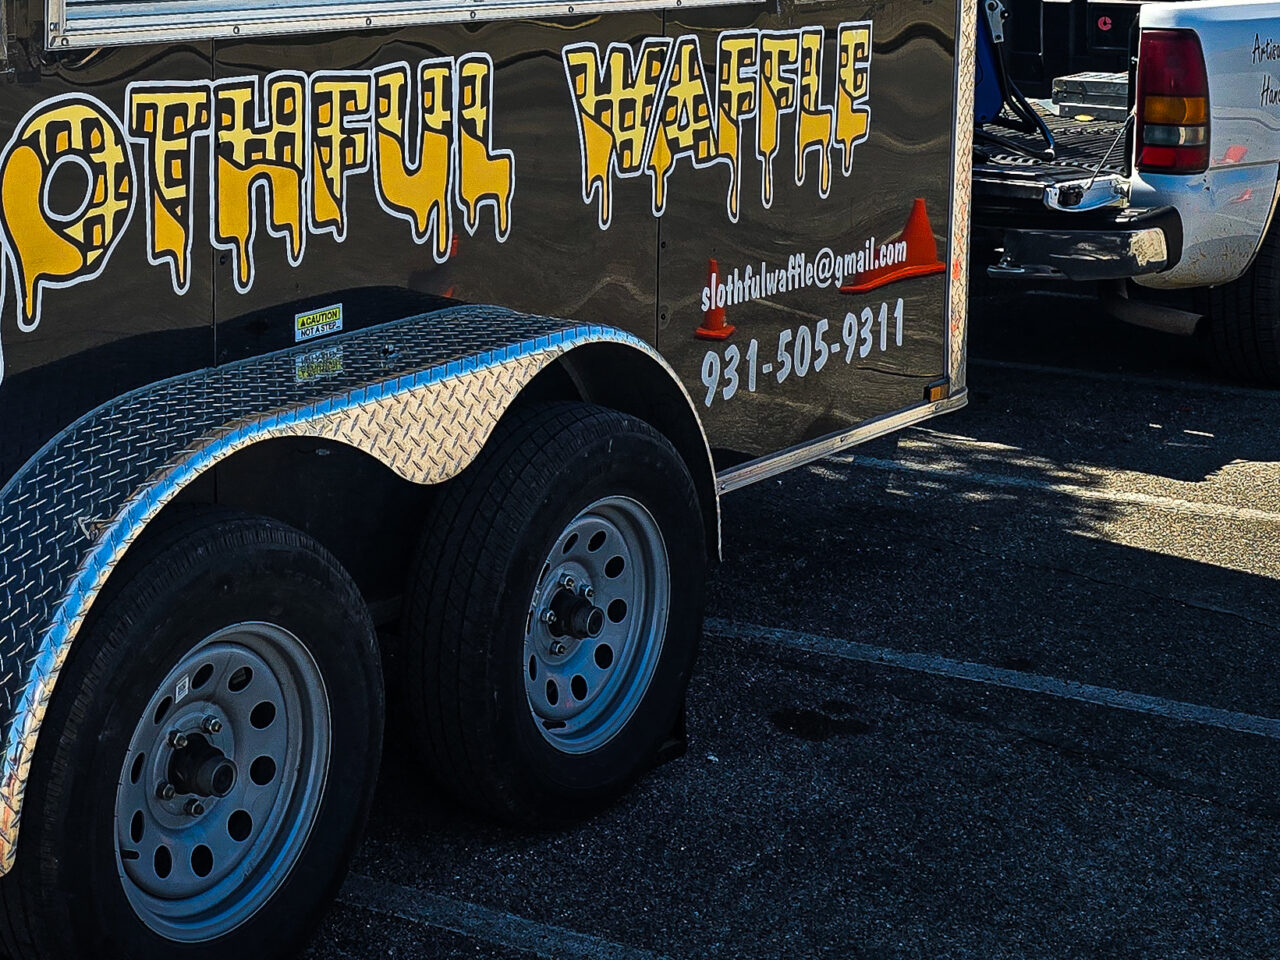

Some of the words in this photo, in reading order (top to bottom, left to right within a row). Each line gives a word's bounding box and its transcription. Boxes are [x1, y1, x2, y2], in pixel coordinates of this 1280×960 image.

[561, 19, 873, 230] WAFFLE
[701, 236, 907, 313] slothfulwaffle@gmail.com
[300, 327, 314, 338] NOT
[320, 322, 337, 332] STEP
[305, 309, 338, 326] CAUTION
[701, 297, 904, 407] 931-505-9311
